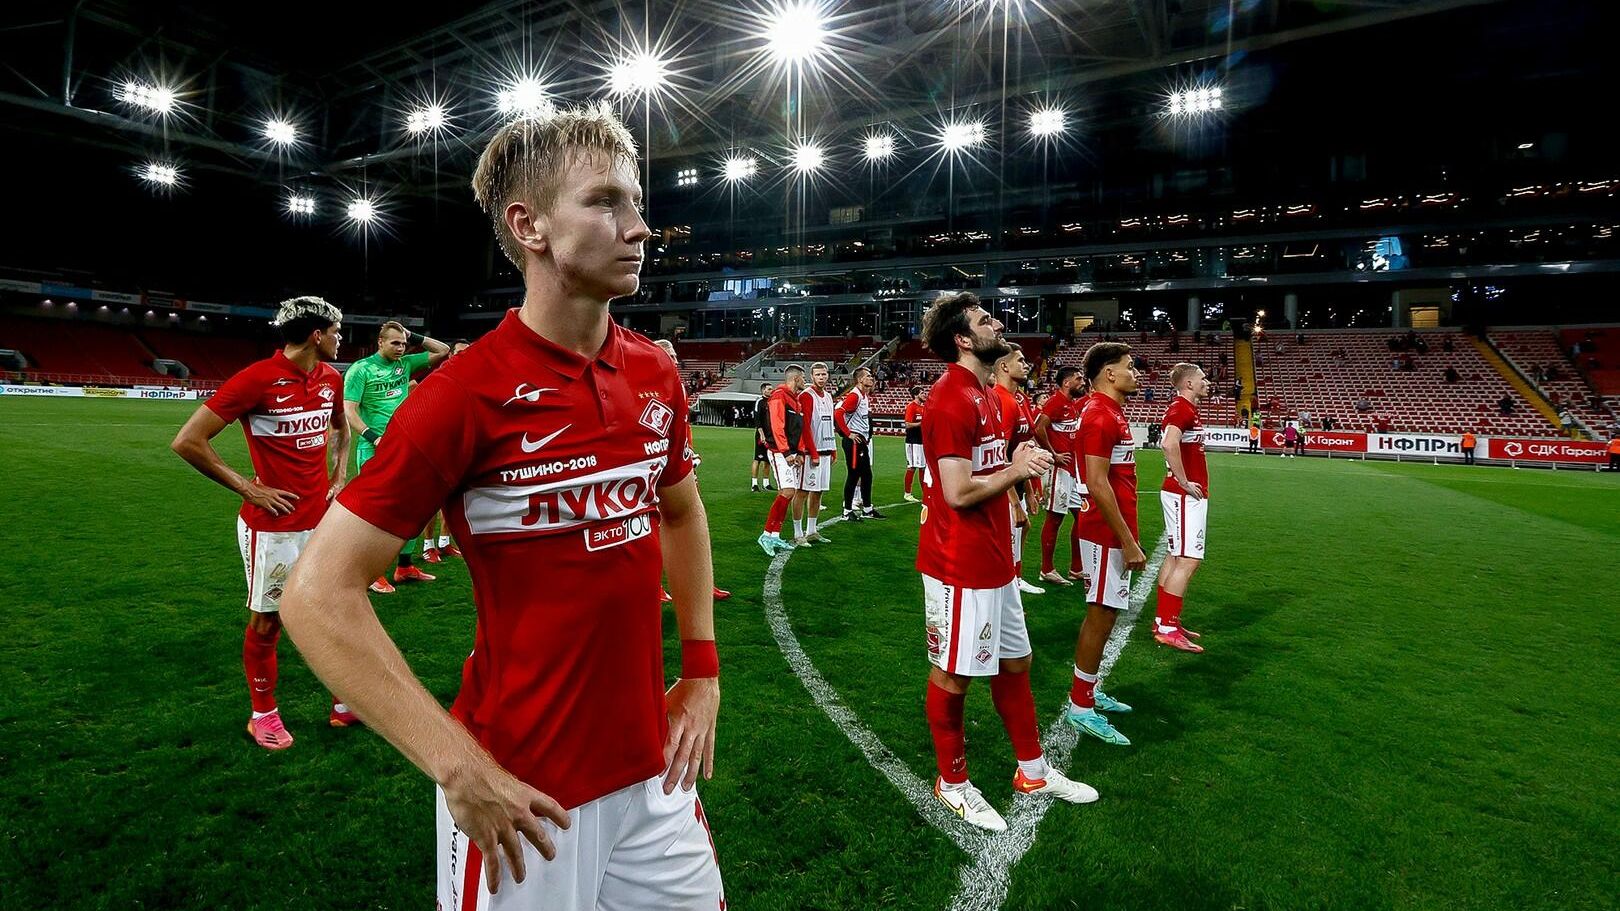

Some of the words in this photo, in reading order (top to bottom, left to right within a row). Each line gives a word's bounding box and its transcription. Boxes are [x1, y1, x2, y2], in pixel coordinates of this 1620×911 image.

[6, 386, 54, 394] открытие
[140, 390, 186, 399] НФПРиР
[1204, 433, 1250, 442] НФПРи
[1317, 435, 1354, 446] Гарант
[1378, 436, 1460, 453] НФПРи
[1528, 444, 1559, 457] СДК
[1561, 445, 1608, 458] Гарант
[500, 455, 597, 482] ТУШИНО-2018
